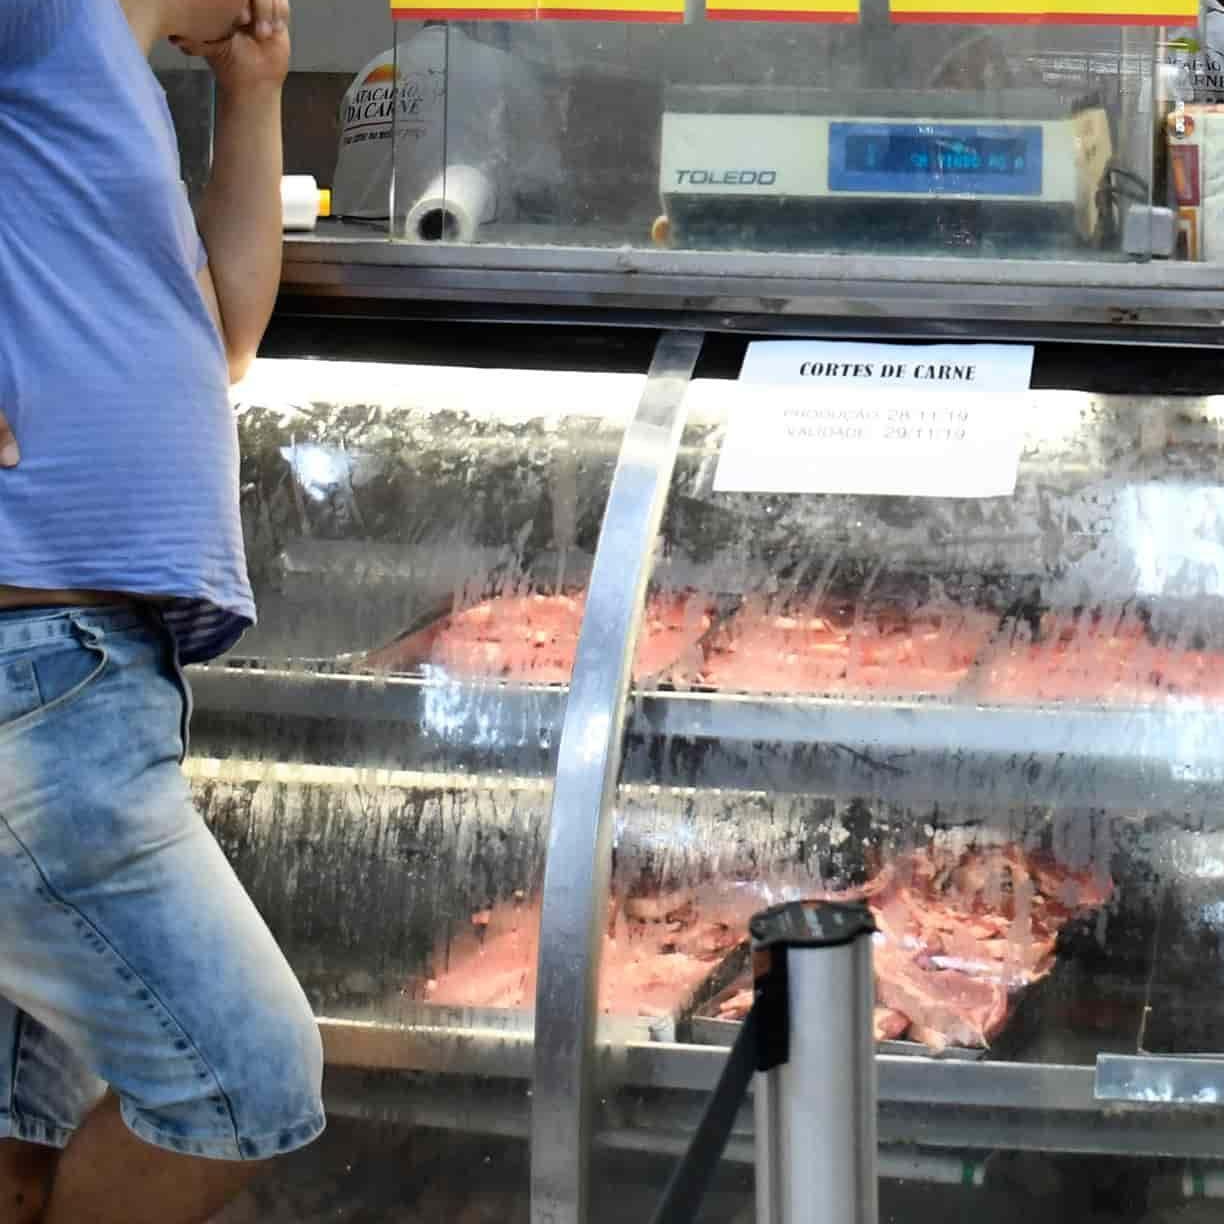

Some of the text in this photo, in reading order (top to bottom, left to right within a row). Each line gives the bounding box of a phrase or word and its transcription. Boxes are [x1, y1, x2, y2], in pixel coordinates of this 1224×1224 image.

[675, 170, 777, 185] TOLEDO
[799, 361, 976, 381] CORTES DE CARNE
